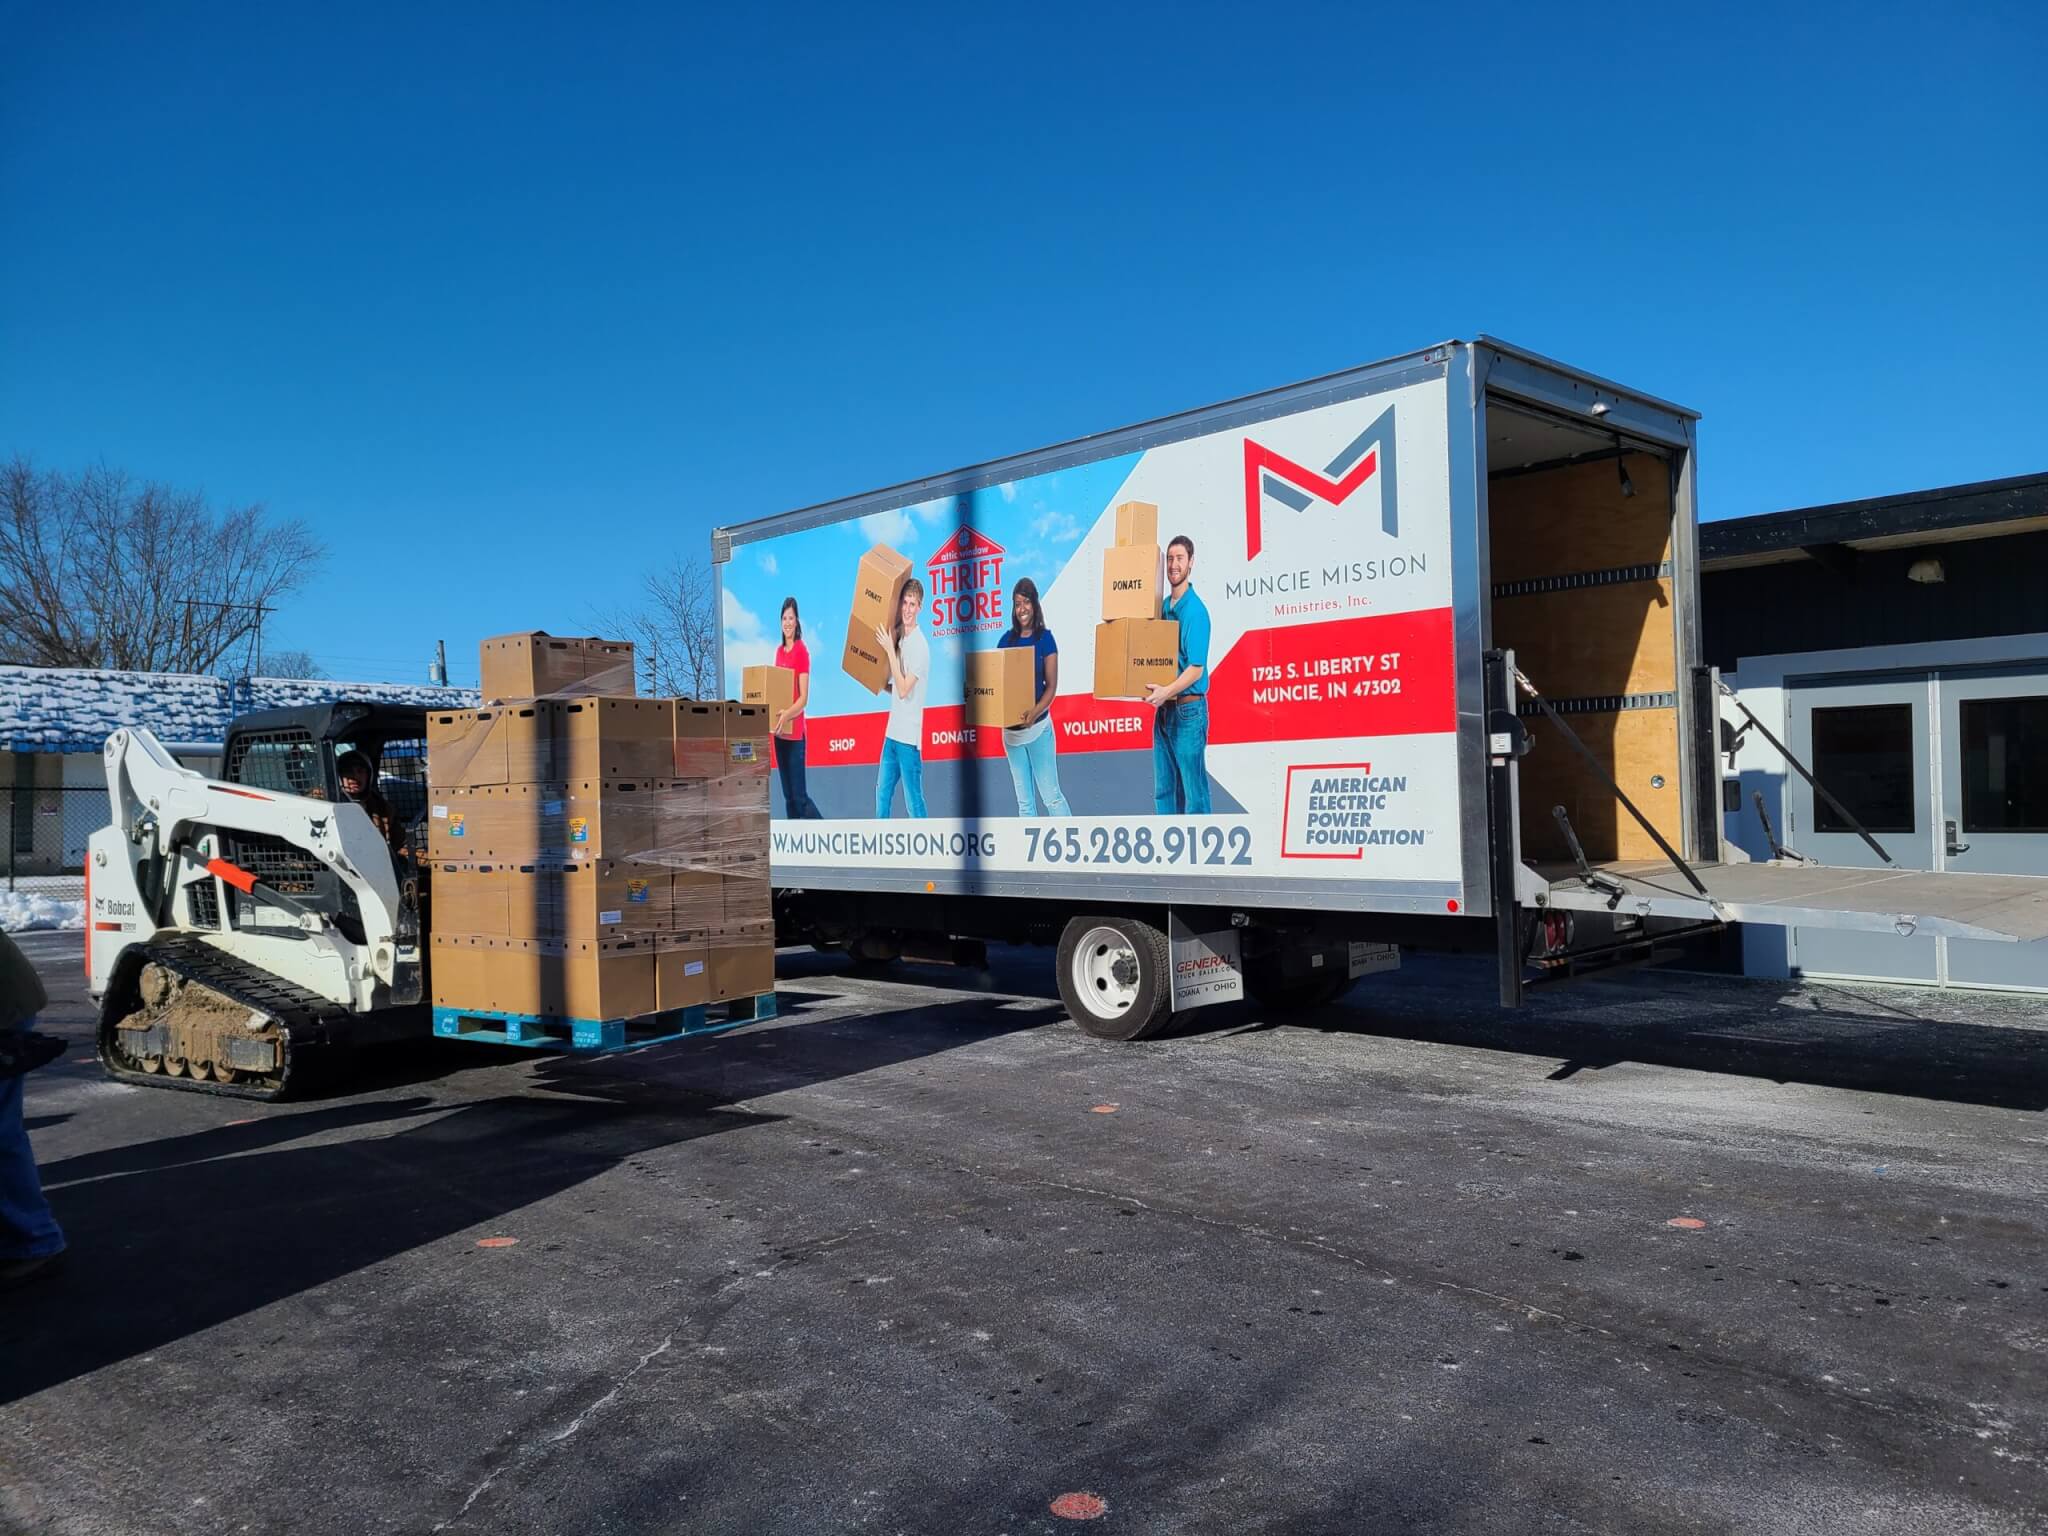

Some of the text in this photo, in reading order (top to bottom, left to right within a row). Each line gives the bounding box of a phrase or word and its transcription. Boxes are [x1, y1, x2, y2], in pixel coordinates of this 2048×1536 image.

[941, 545, 989, 561] attic window
[929, 557, 1004, 596] THRIFT
[1112, 579, 1142, 591] DONATE
[1226, 552, 1427, 600] MUNCIE MISSION
[932, 589, 1003, 627] STORE
[1347, 595, 1372, 608] Inc.
[932, 620, 1003, 638] AND DONATION CENTER
[1133, 658, 1174, 667] FOR MISSION
[1252, 652, 1401, 682] 1725 S. LIBERTY ST
[974, 687, 994, 696] DONATE
[1253, 678, 1402, 704] MUNCIE, IN 47302
[1062, 717, 1143, 737] VOLUNTEER
[829, 738, 856, 752] SHOP
[931, 729, 977, 745] DONATE
[1310, 776, 1407, 794] AMERICAN
[1308, 795, 1387, 811] ELECTRIC
[1307, 812, 1372, 828] POWER
[771, 832, 996, 857] W.MUNCIEMISSION.ORG
[1024, 825, 1253, 866] 765.288.9122
[1306, 829, 1425, 845] FOUNDATION
[107, 899, 135, 917] Bobcat
[1176, 953, 1236, 973] GENERAL
[1213, 981, 1237, 992] OHIO
